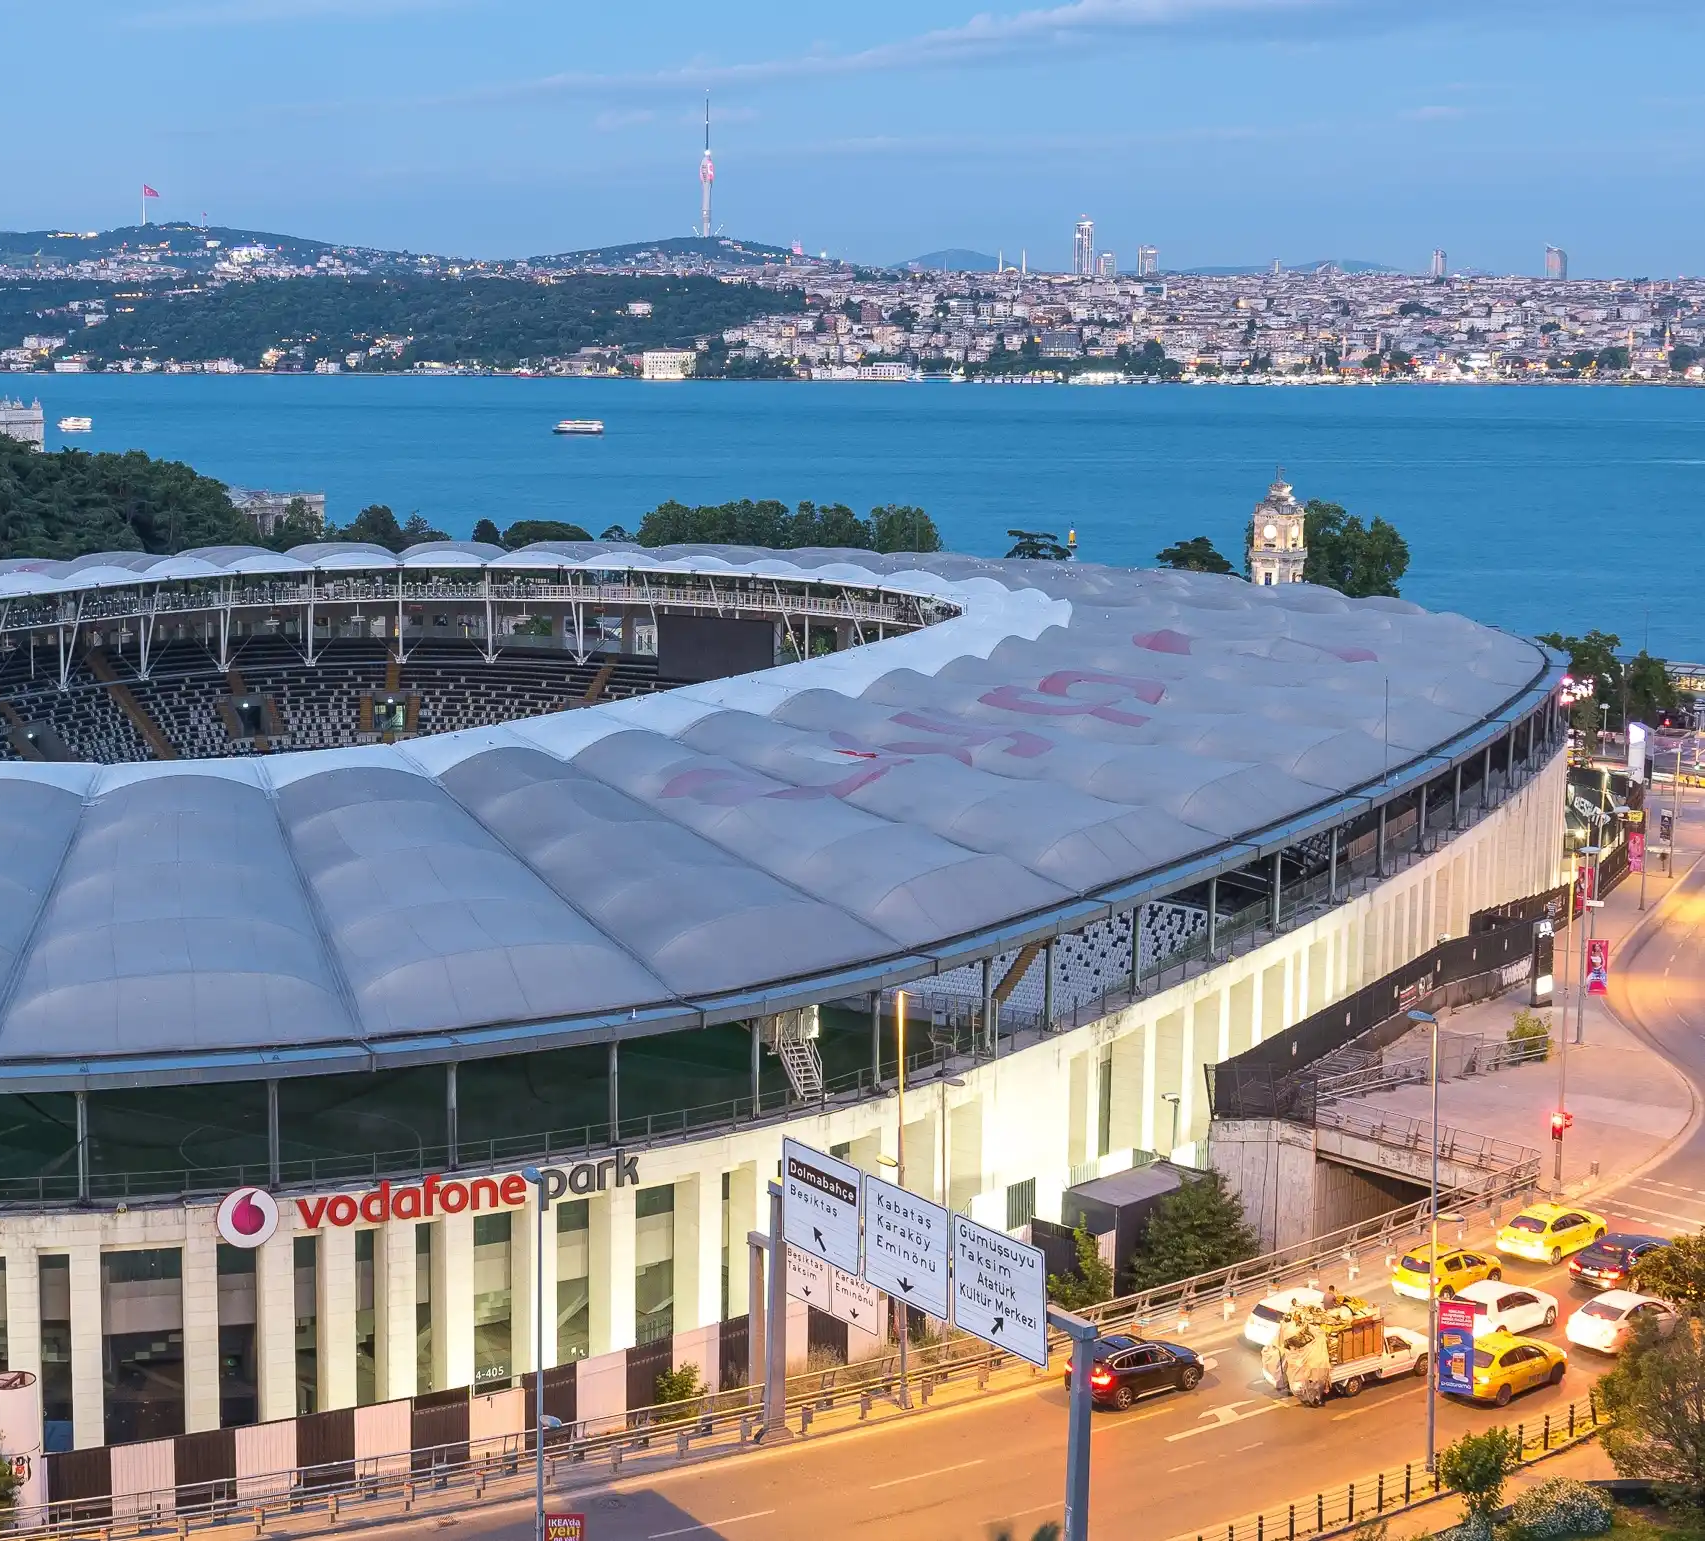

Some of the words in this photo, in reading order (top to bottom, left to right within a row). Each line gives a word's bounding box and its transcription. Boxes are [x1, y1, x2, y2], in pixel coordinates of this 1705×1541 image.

[296, 1174, 528, 1229] vodafone
[540, 1148, 640, 1211] park
[790, 1161, 855, 1201] Dolmabahçe
[790, 1183, 838, 1217] Beşiktaş
[877, 1193, 932, 1230] Kabataş
[877, 1213, 931, 1251] Karaköy
[959, 1224, 1035, 1269] Gümüşsuyu
[787, 1259, 817, 1280] Taksim
[876, 1234, 936, 1273] Eminönü
[959, 1243, 1011, 1279] Taksim
[977, 1271, 1017, 1302] Atatürk
[959, 1282, 992, 1308] Kültür
[995, 1298, 1037, 1330] Merkezi
[476, 1366, 504, 1380] 4-405
[548, 1518, 581, 1527] IKEA'da
